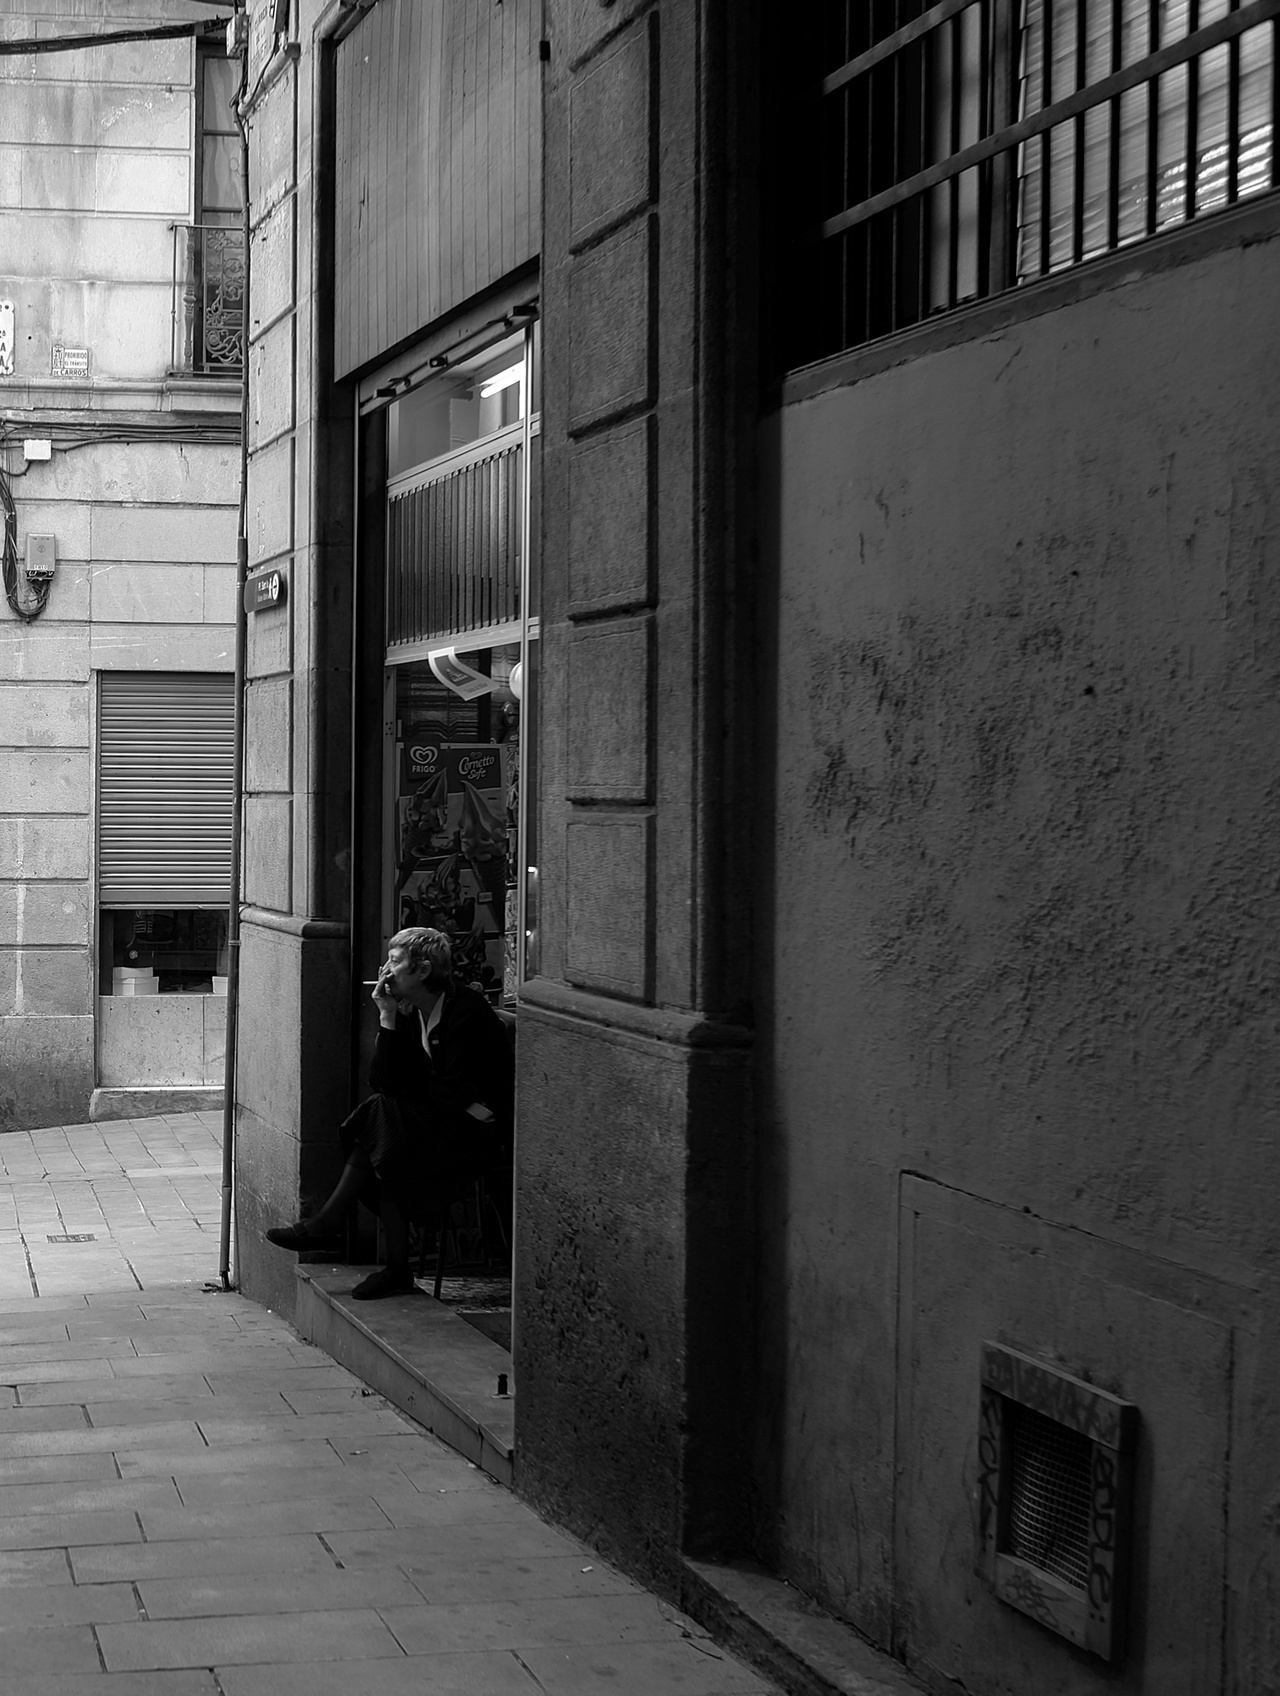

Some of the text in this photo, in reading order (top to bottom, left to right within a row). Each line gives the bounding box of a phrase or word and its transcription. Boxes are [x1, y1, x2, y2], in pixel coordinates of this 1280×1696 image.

[411, 756, 495, 775] FRIGO Cornetto
[467, 767, 487, 780] Soft
